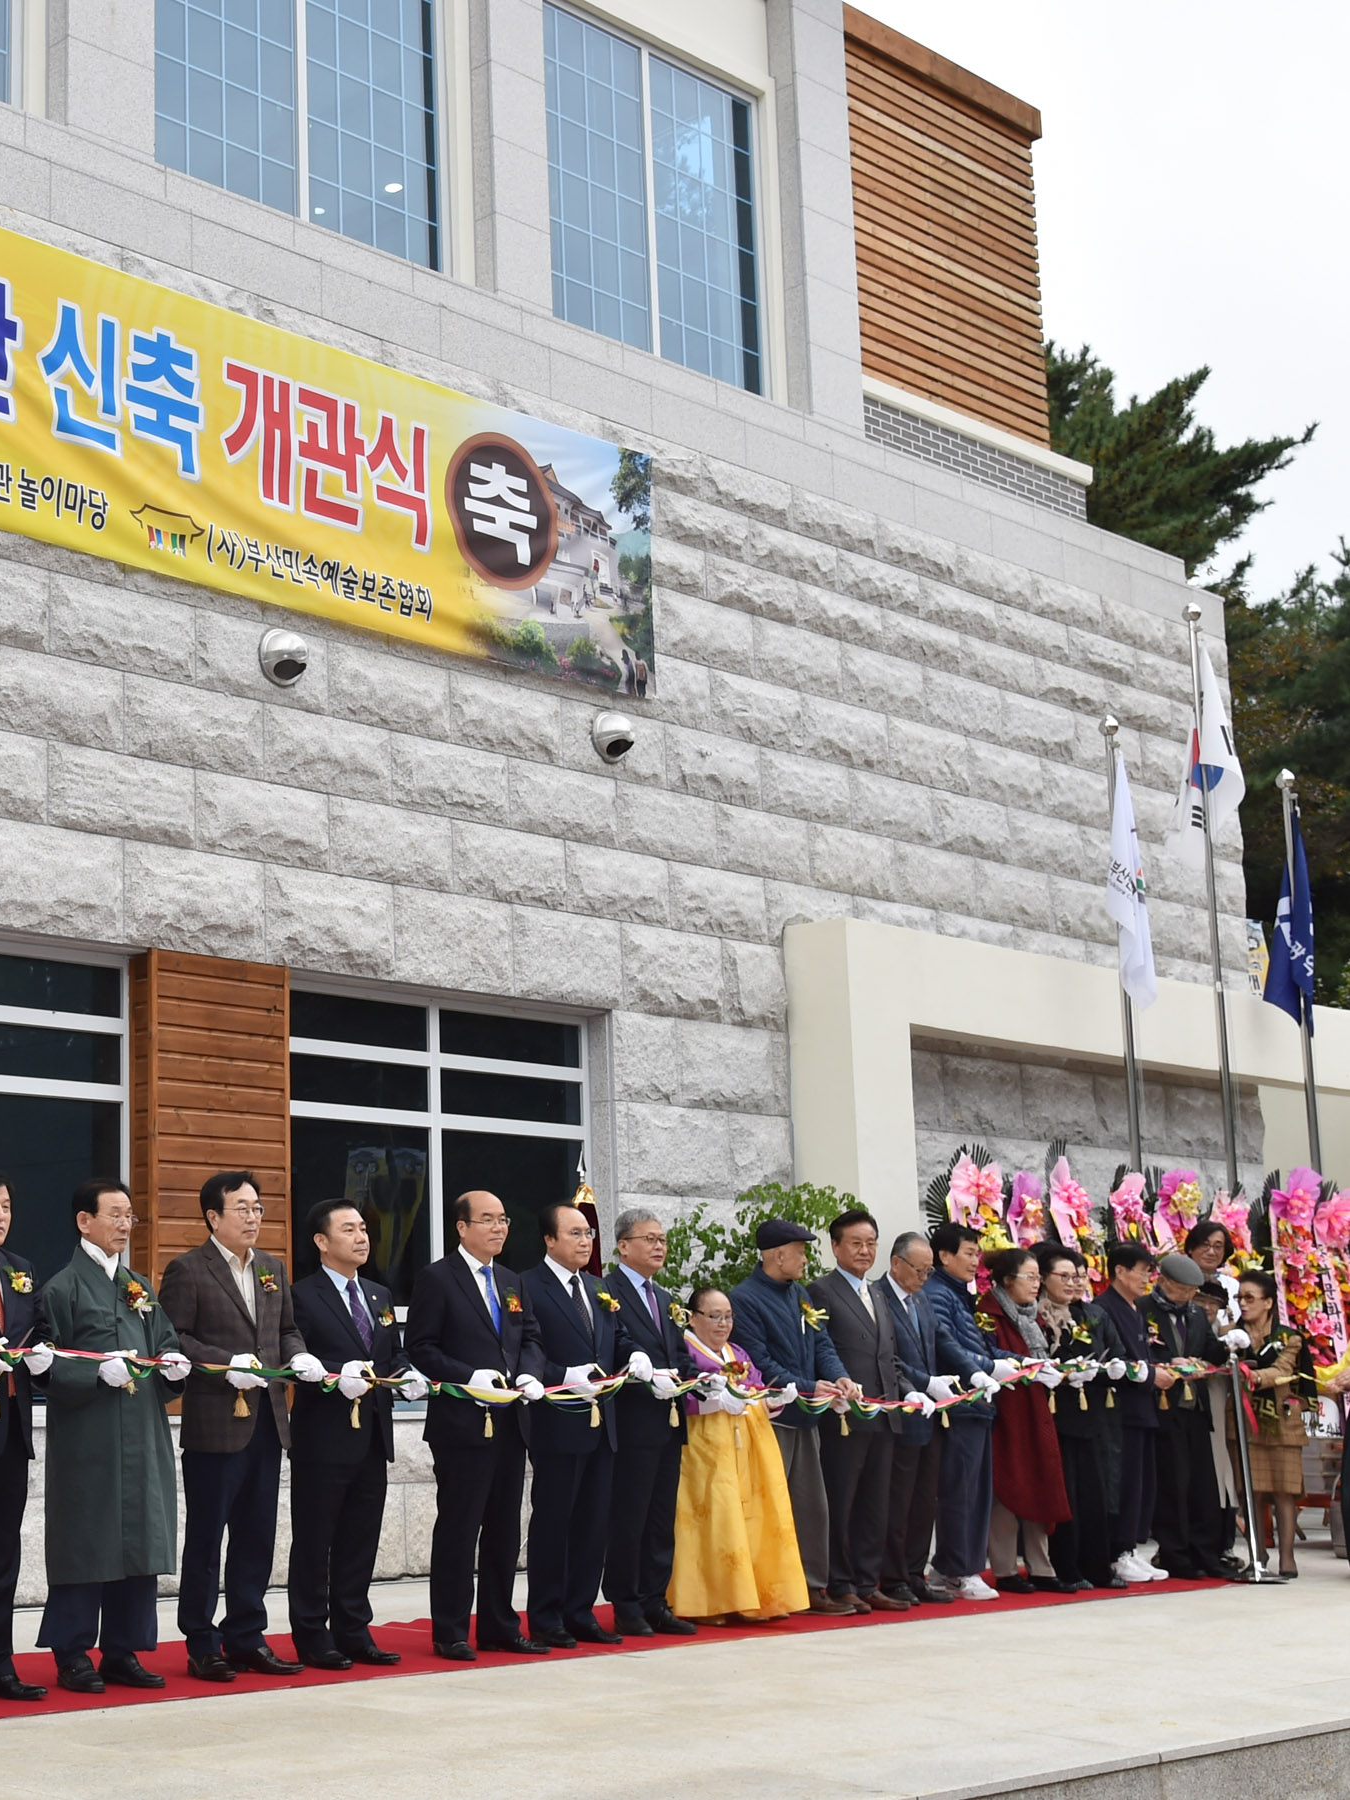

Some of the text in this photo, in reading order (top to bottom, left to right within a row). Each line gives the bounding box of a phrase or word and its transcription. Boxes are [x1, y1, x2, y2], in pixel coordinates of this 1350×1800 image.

[41, 304, 200, 474] 신축
[224, 362, 431, 550] 개관식
[17, 467, 109, 531] 놀이마당
[464, 461, 539, 568] 축
[206, 523, 433, 622] (사)부산민속예술보존협회
